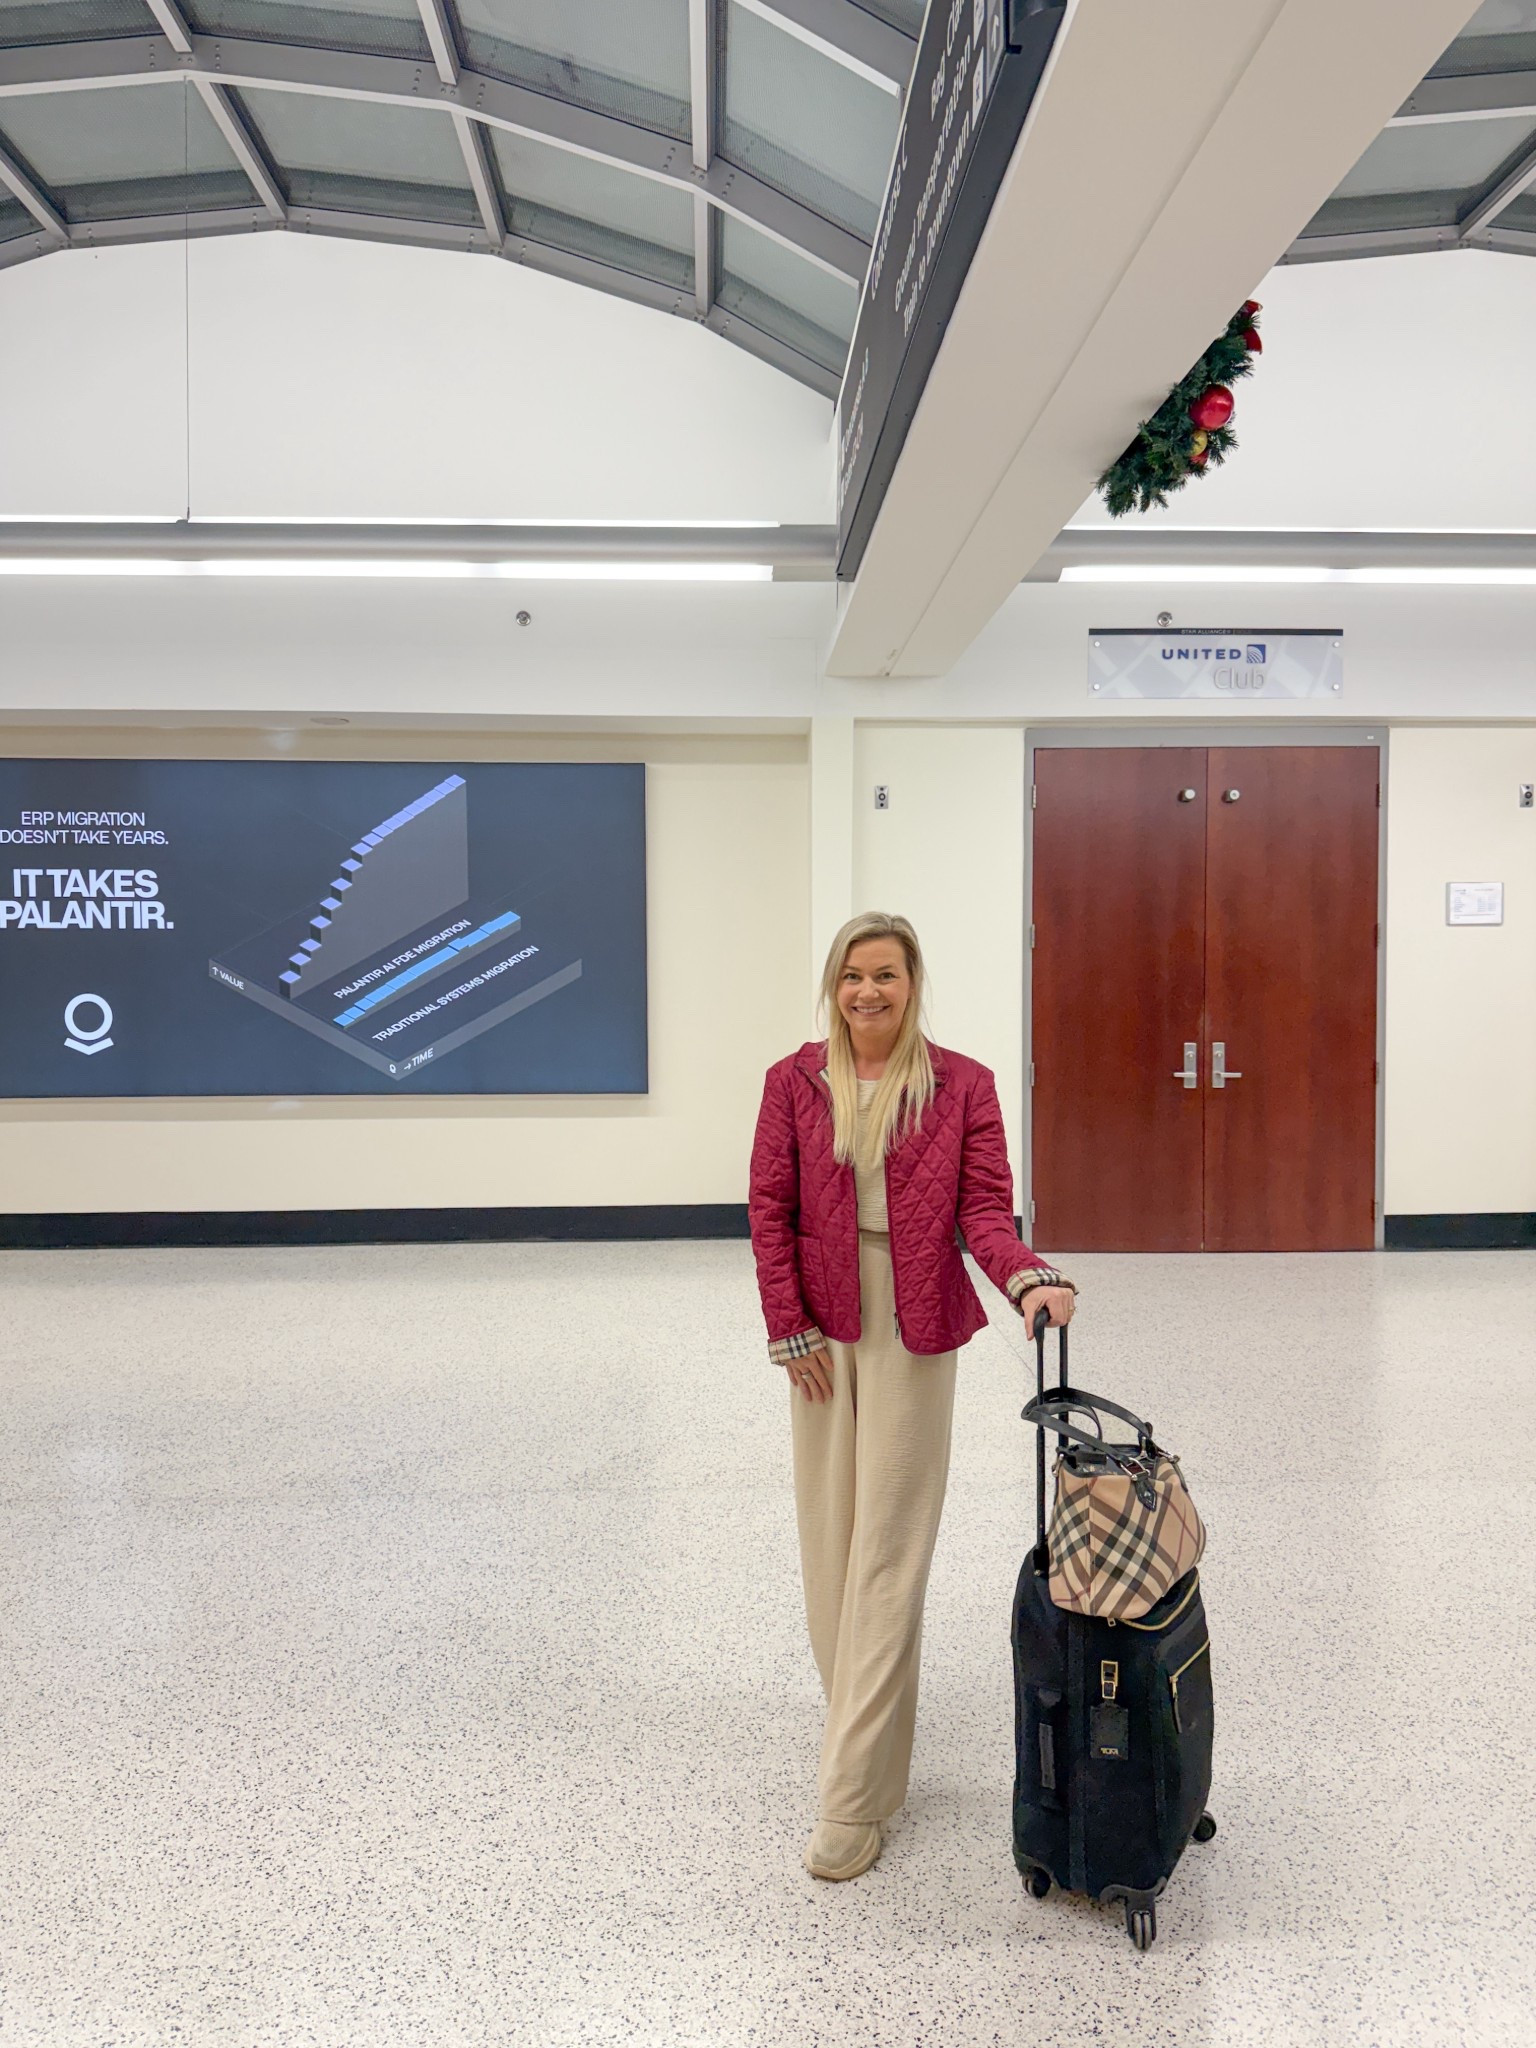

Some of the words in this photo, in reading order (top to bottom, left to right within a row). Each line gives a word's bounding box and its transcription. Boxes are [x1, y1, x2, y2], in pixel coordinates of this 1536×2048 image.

[931, 49, 945, 122] Bag
[946, 0, 965, 57] Cla
[895, 218, 916, 312] Ground
[917, 34, 970, 239] Transportation
[871, 163, 901, 300] Concourse
[902, 122, 908, 171] C
[904, 280, 918, 338] Train
[918, 255, 926, 290] to
[927, 110, 970, 266] Downtown
[1161, 648, 1242, 660] UNITED
[1213, 667, 1265, 690] Club
[21, 811, 55, 826] ERP
[57, 811, 145, 827] MIGRATION
[0, 829, 70, 844] DOESN'T
[71, 830, 110, 844] TAKE
[112, 830, 169, 845] YEARS.
[13, 868, 44, 897] IT
[46, 868, 159, 899] TAKES
[0, 900, 174, 930] PALANTIR.
[333, 968, 386, 999] PALANTIR
[382, 961, 396, 973] AI
[392, 949, 418, 967] FDE
[413, 918, 472, 956] MIGRATION
[219, 970, 245, 990] VALUE
[371, 1002, 441, 1042] TRADITIONAL
[436, 976, 485, 1006] SYSTEMS
[481, 944, 540, 980] MIGRATION
[411, 1047, 434, 1067] TIME
